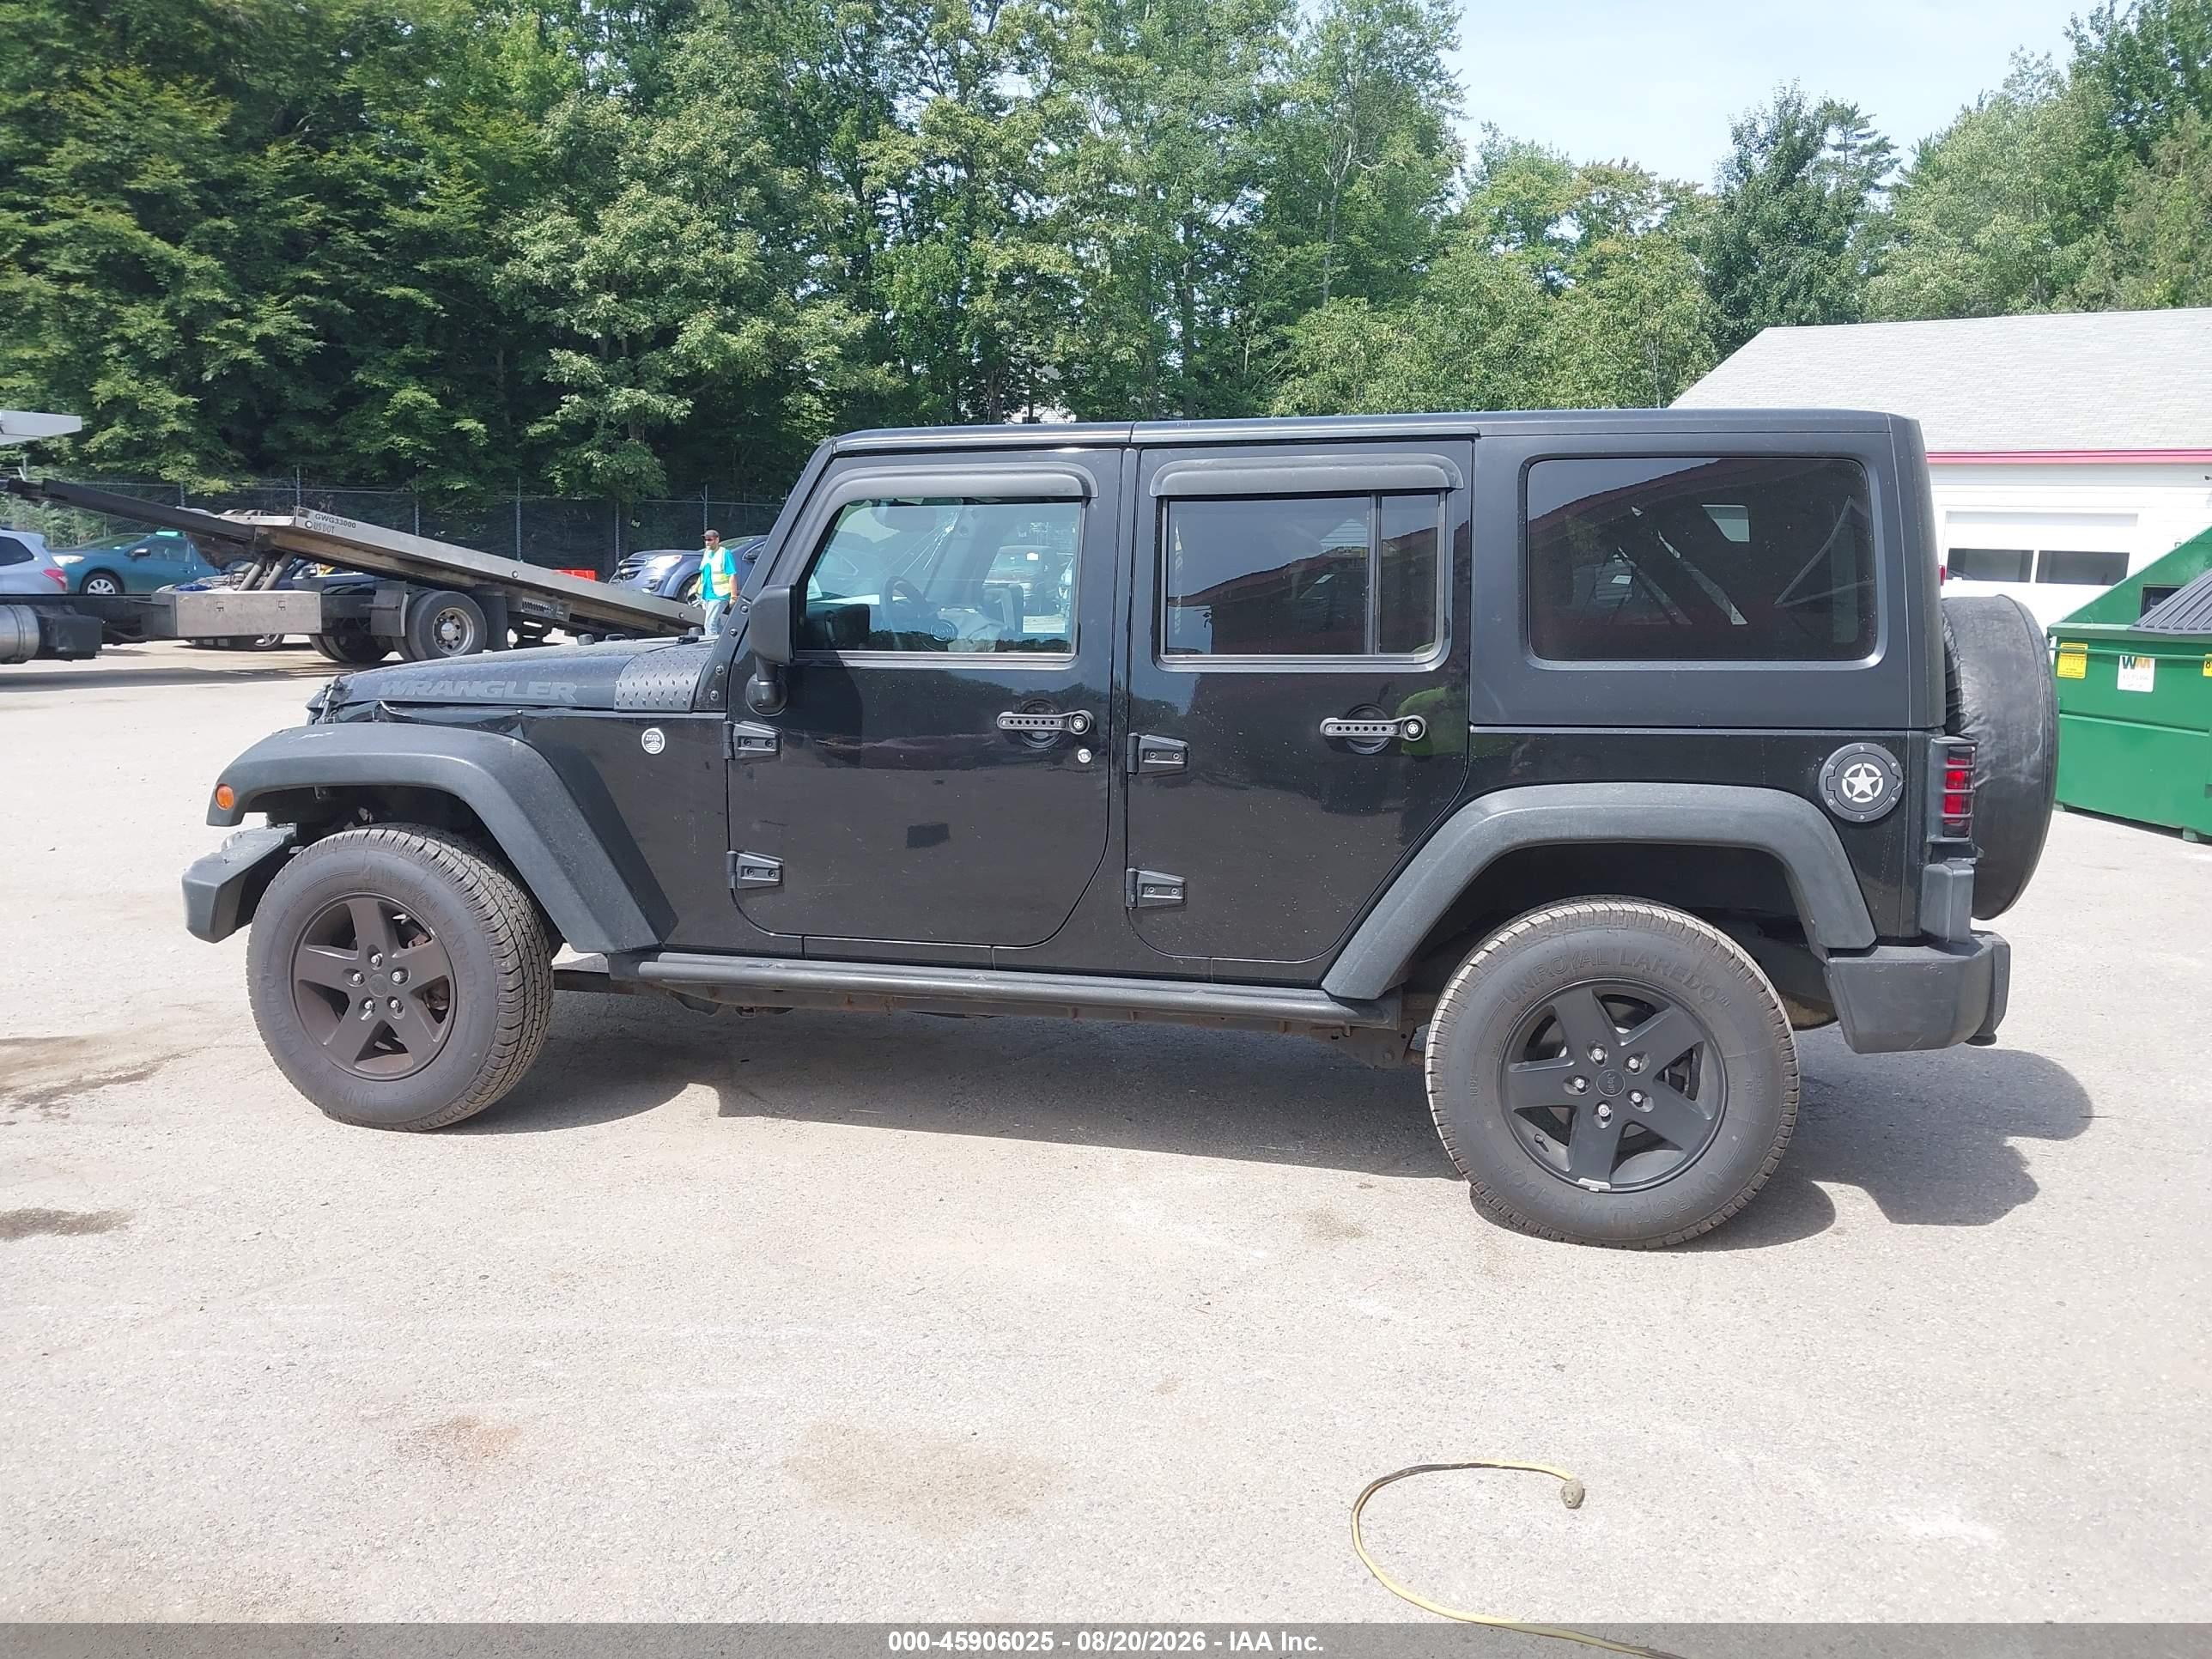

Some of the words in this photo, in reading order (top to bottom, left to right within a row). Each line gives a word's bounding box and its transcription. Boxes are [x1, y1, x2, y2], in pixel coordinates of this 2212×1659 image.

[378, 680, 578, 703] WRANGLER
[1504, 947, 1608, 1003] UNIROYAL
[1620, 947, 1717, 1002] LAREDO
